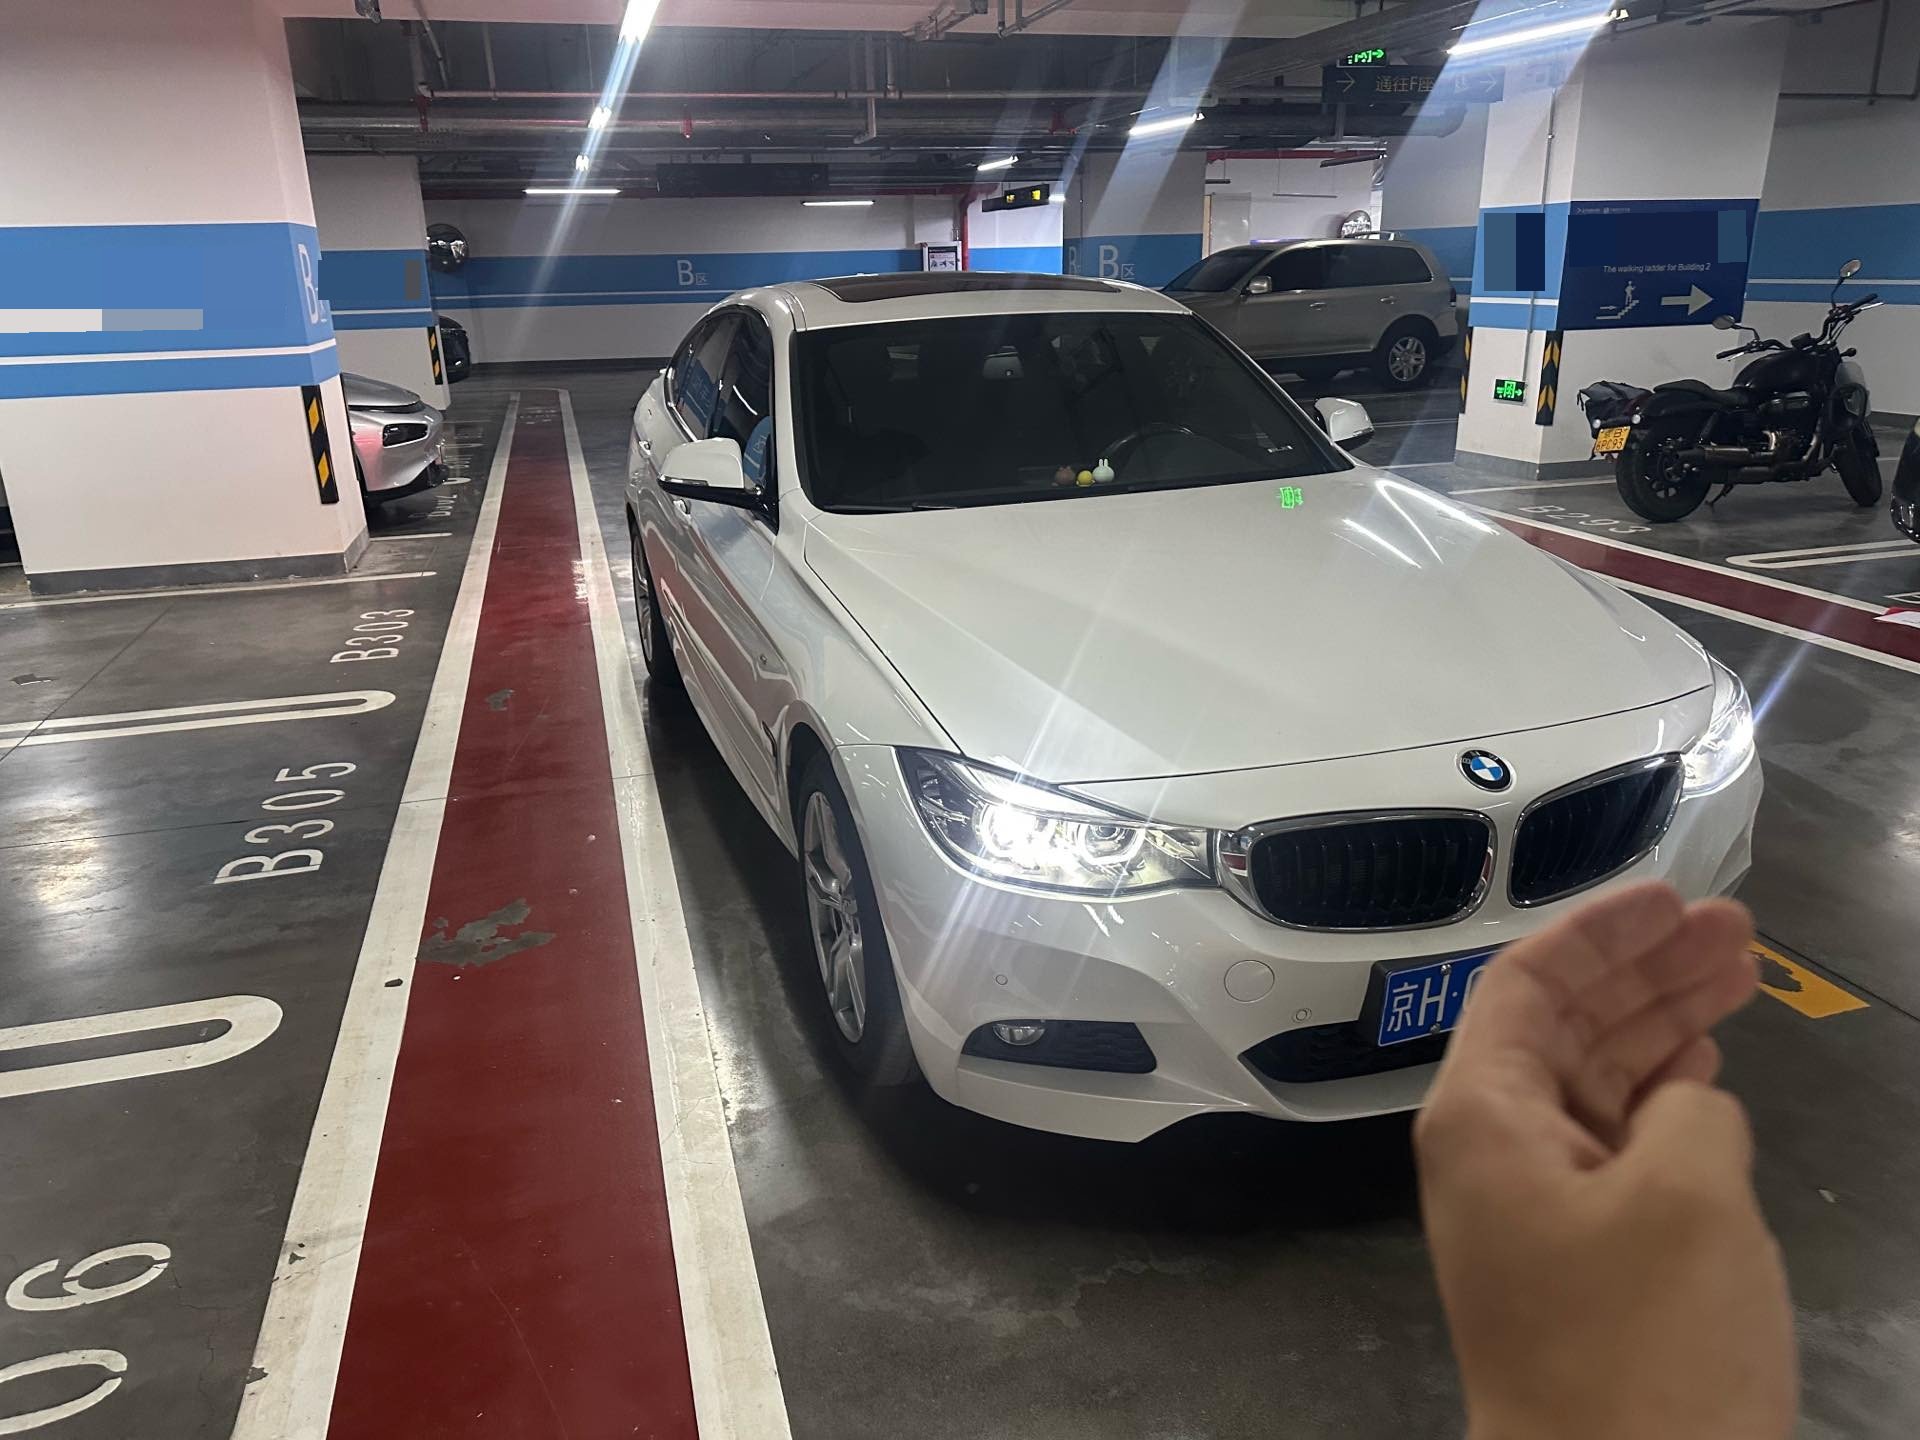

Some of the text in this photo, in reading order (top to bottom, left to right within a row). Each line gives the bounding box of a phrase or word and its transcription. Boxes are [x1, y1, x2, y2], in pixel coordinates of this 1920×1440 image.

[1603, 265, 1616, 273] The
[1617, 264, 1644, 274] walking
[1645, 263, 1666, 272] ladder
[1666, 263, 1677, 271] for
[1677, 262, 1705, 272] Building
[1518, 505, 1652, 533] B293
[329, 609, 414, 663] B303
[211, 761, 356, 885] B305
